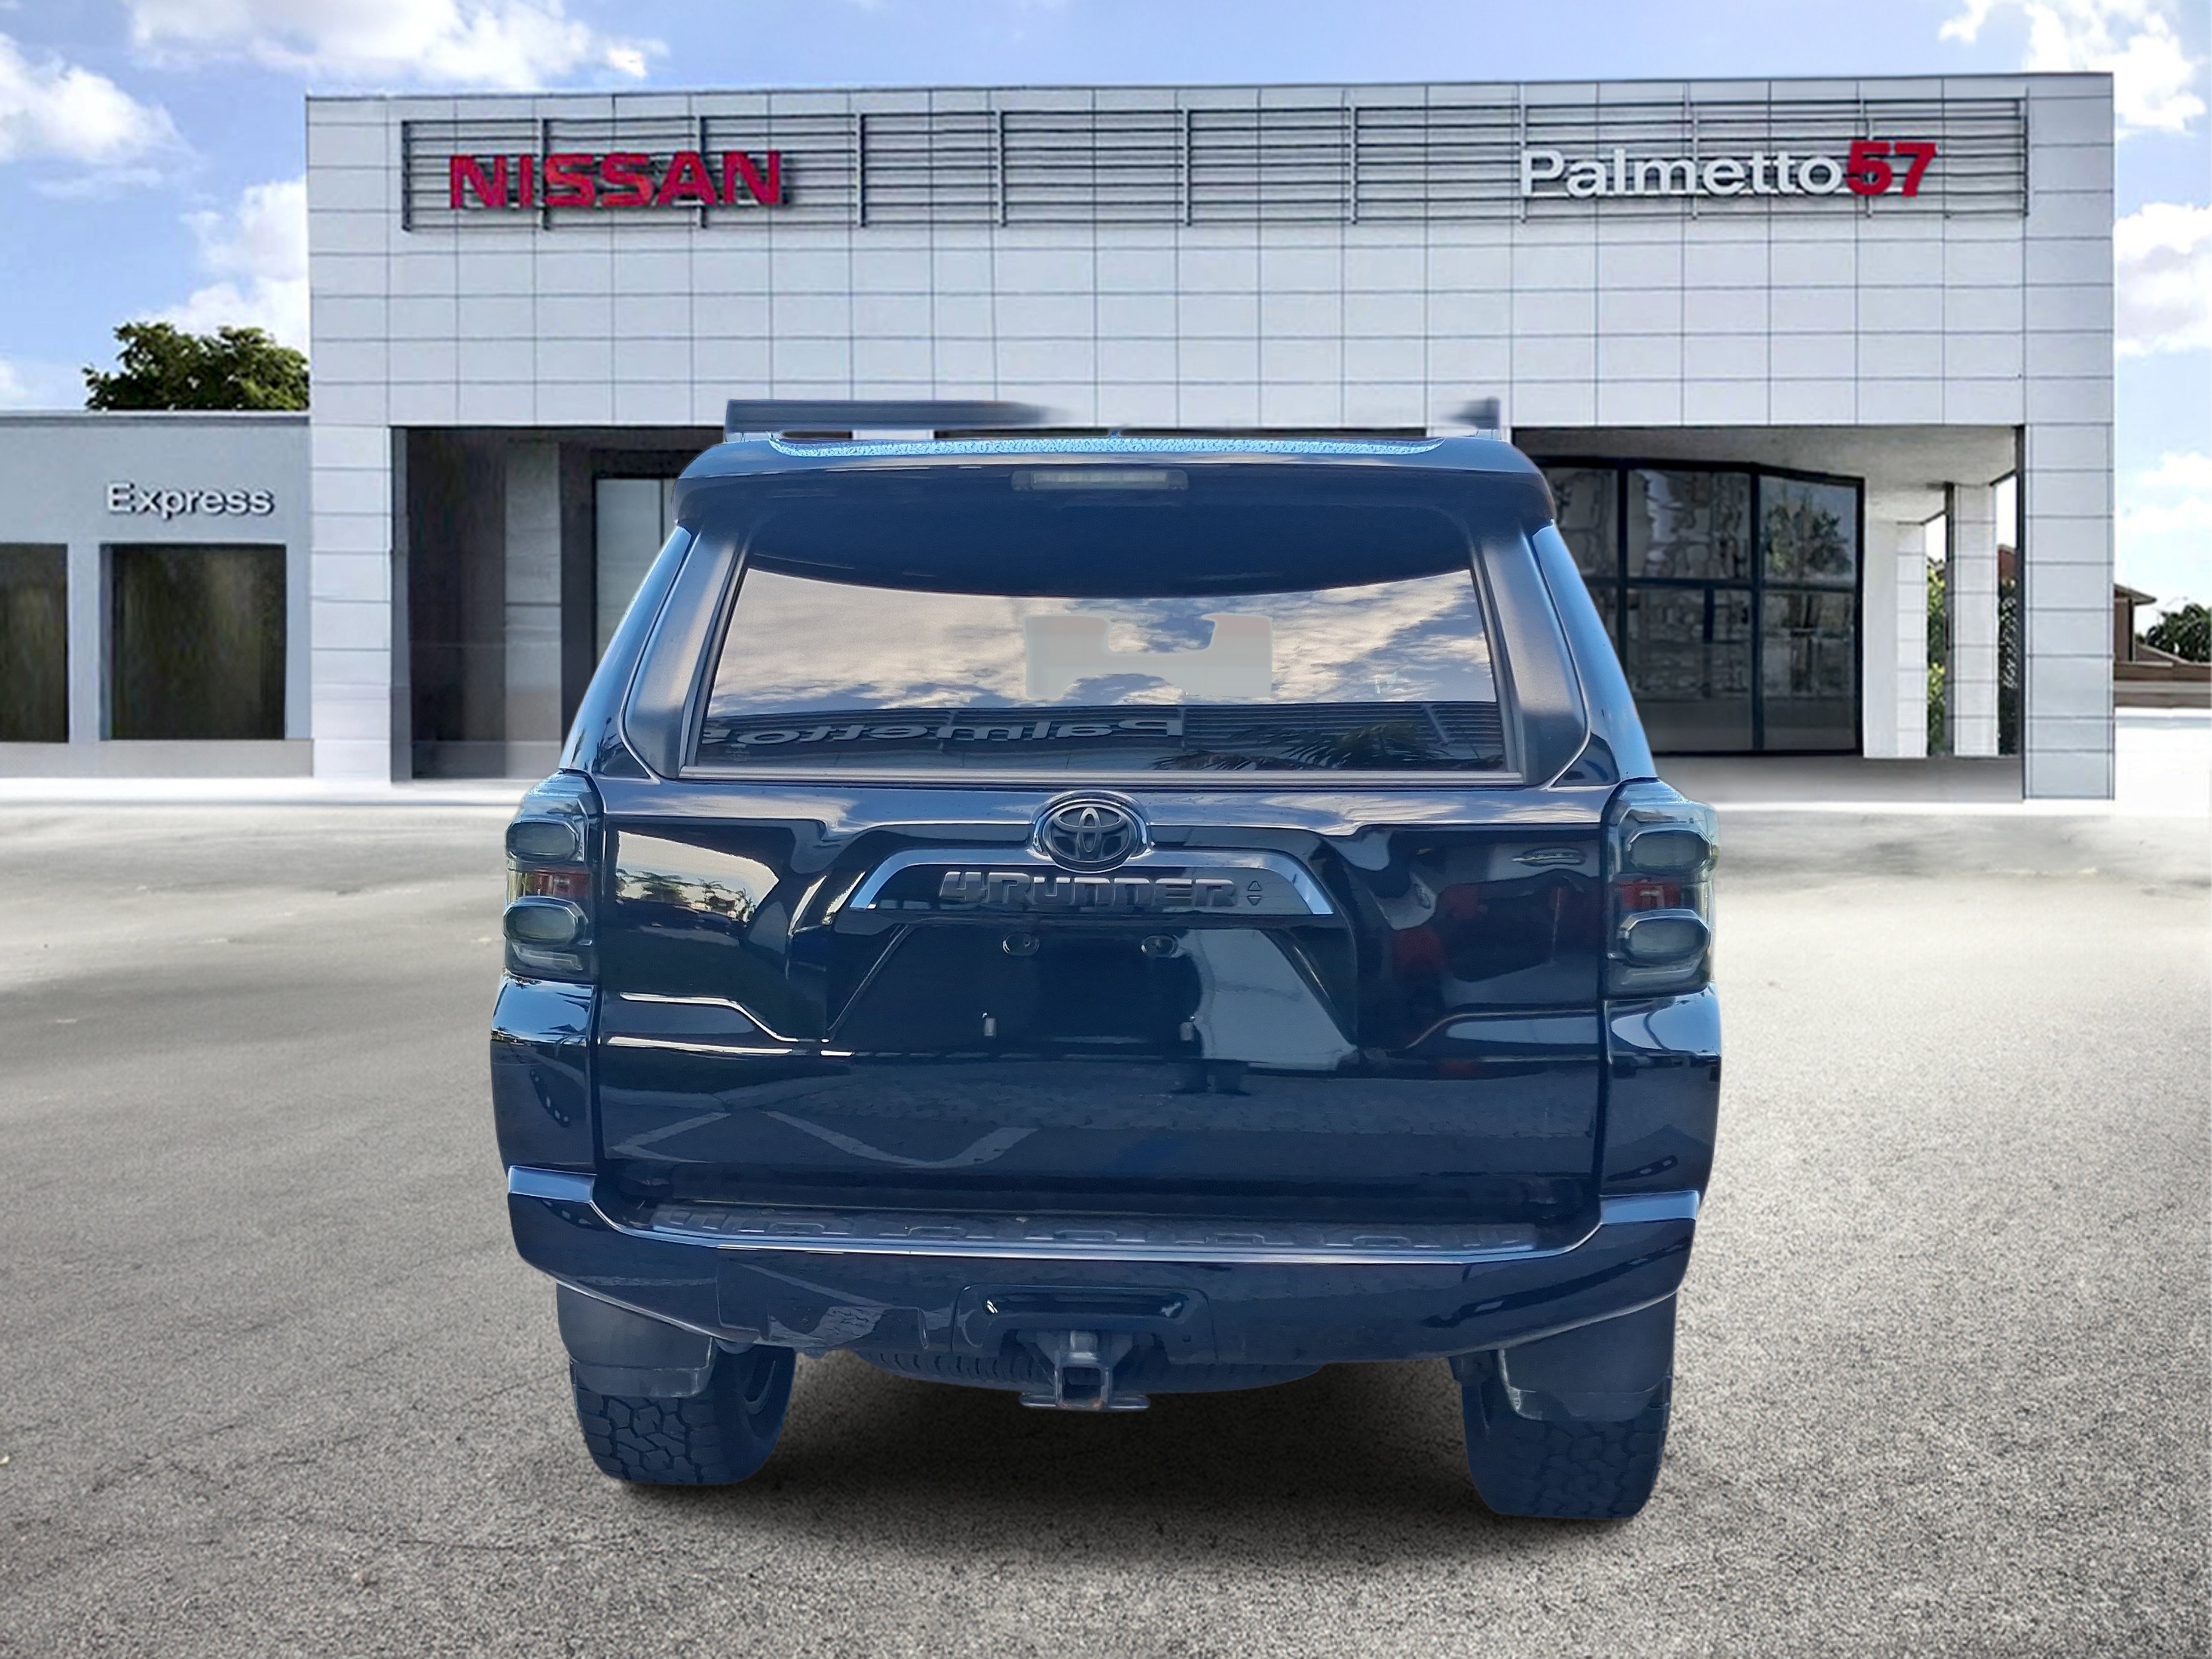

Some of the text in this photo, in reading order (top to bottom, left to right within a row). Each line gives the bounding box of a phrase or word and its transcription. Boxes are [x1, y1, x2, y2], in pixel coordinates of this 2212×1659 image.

[450, 150, 782, 209] NISSAN
[108, 483, 274, 520] Express
[939, 871, 1237, 907] 4RUNNER
